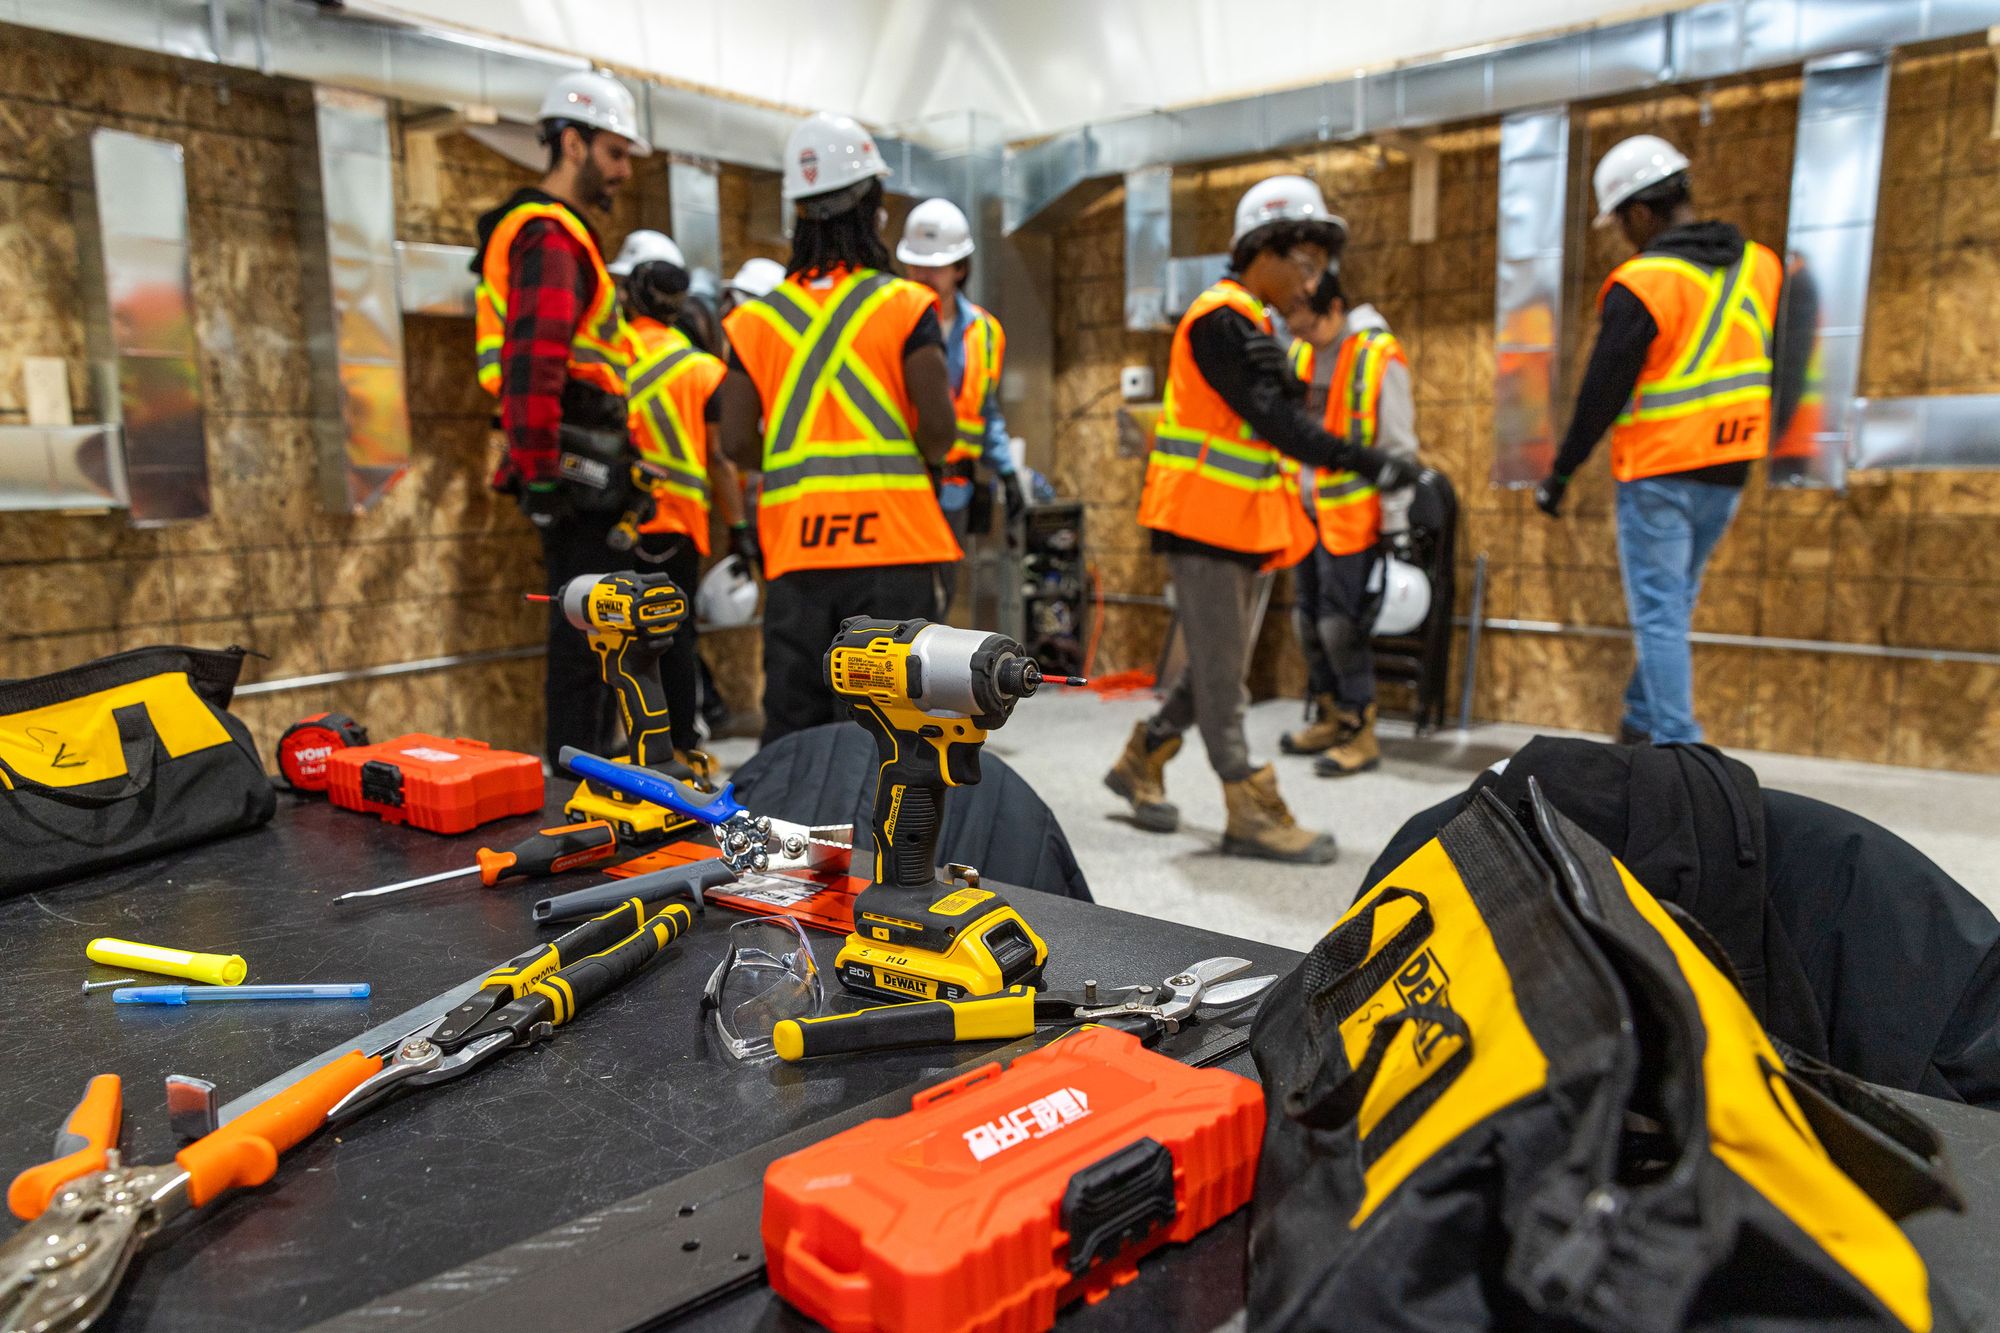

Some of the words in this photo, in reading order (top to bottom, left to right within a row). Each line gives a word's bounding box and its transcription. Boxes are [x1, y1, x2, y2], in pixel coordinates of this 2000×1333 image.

[1716, 415, 1761, 446] UF
[800, 511, 879, 548] UFC
[887, 787, 903, 836] BRUSHLESS
